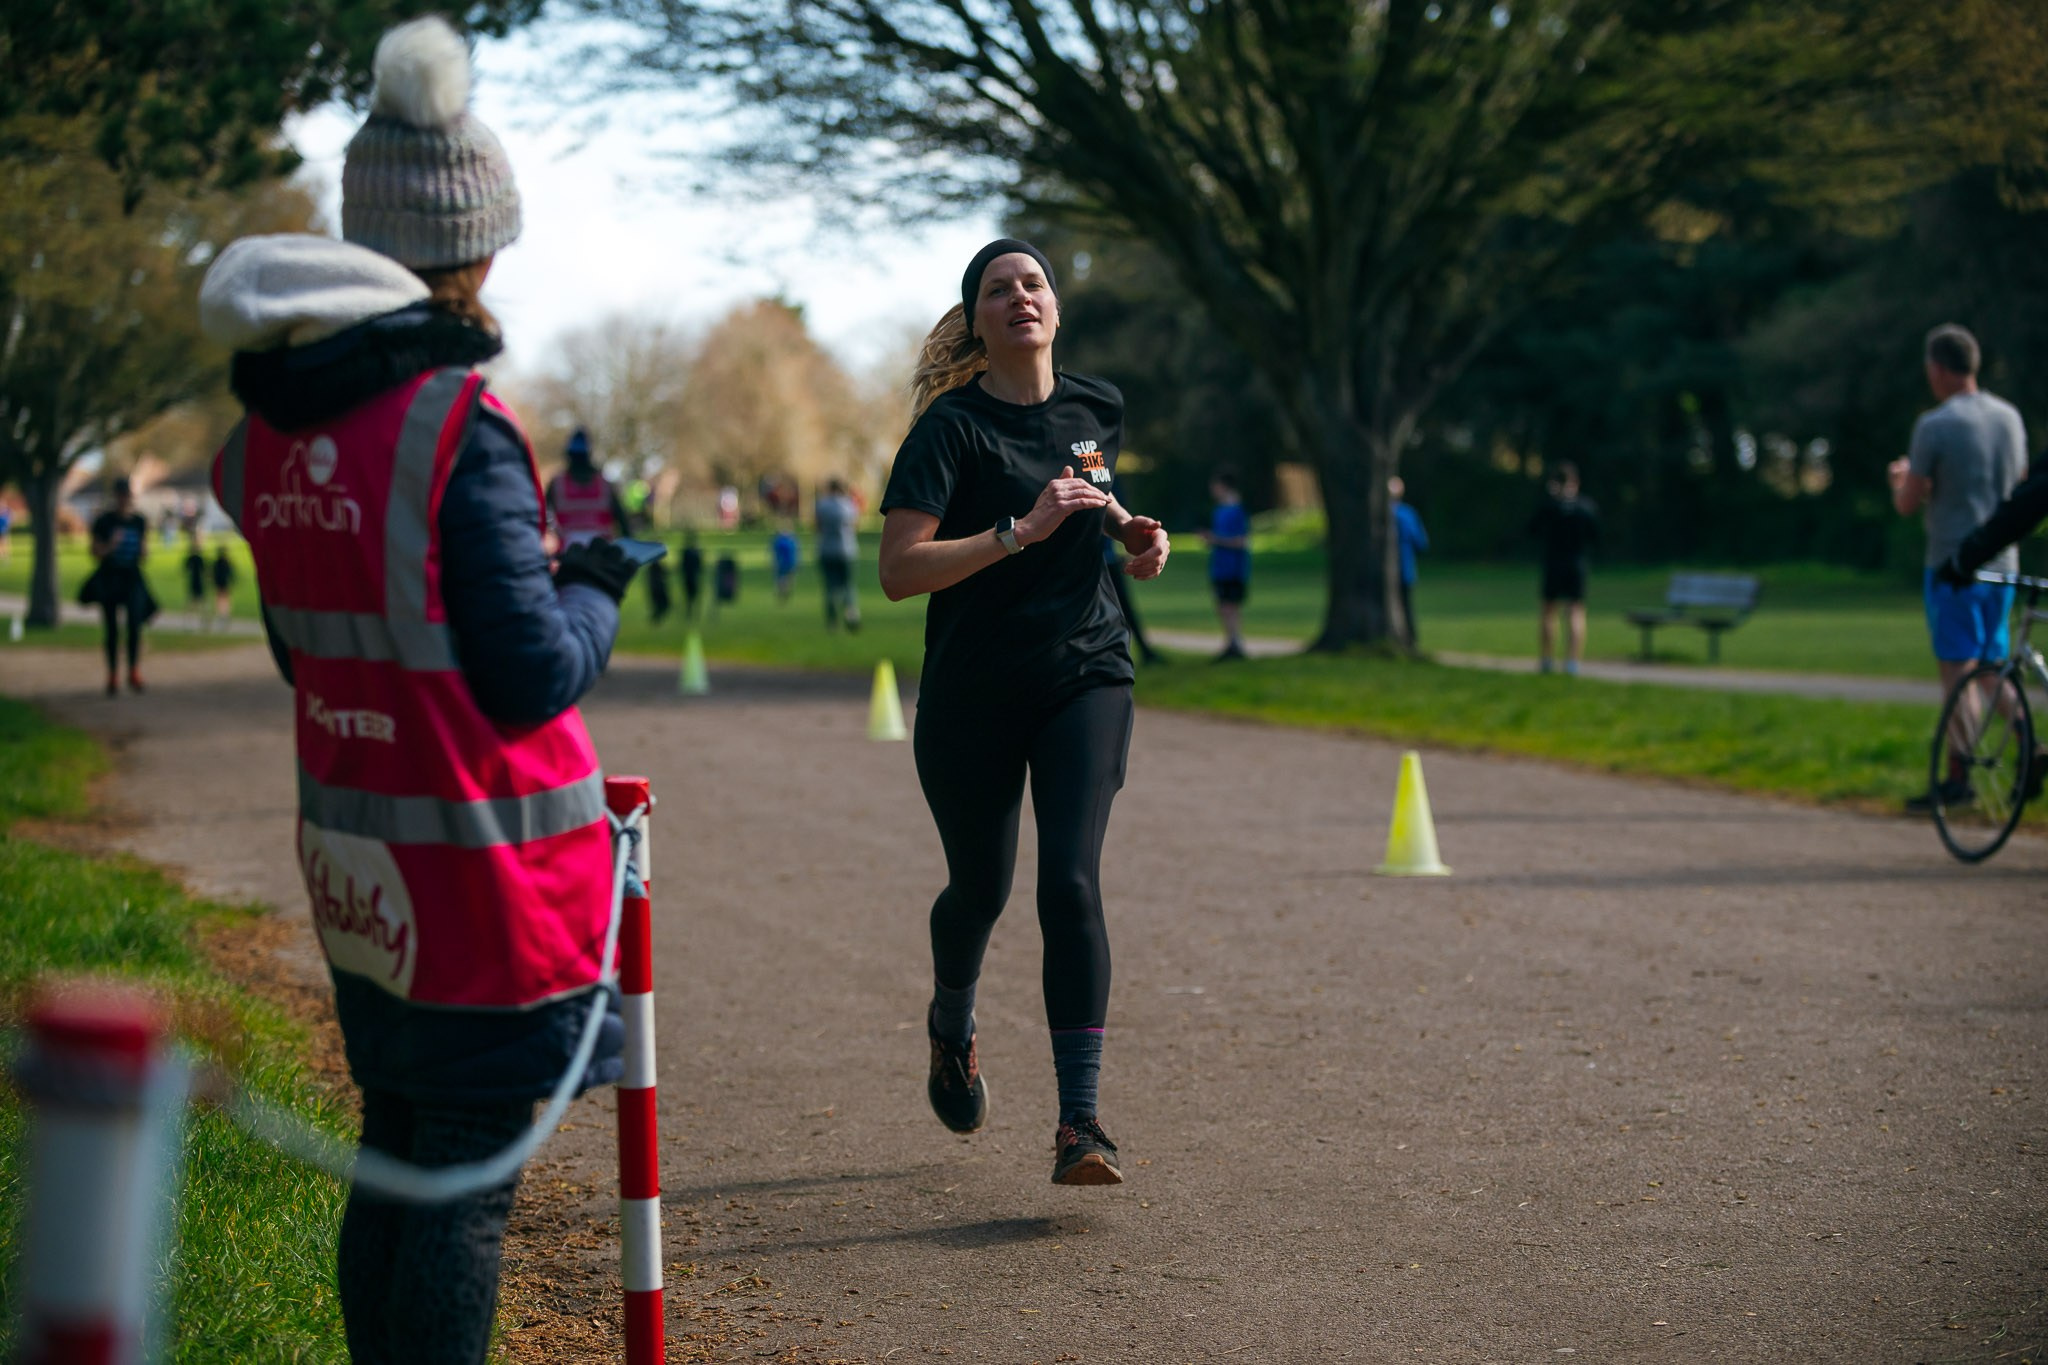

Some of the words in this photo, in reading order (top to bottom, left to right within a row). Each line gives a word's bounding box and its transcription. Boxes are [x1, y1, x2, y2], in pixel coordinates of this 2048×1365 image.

[1070, 440, 1098, 456] SUP
[1080, 454, 1105, 469] BIKE
[1090, 467, 1112, 483] RUN
